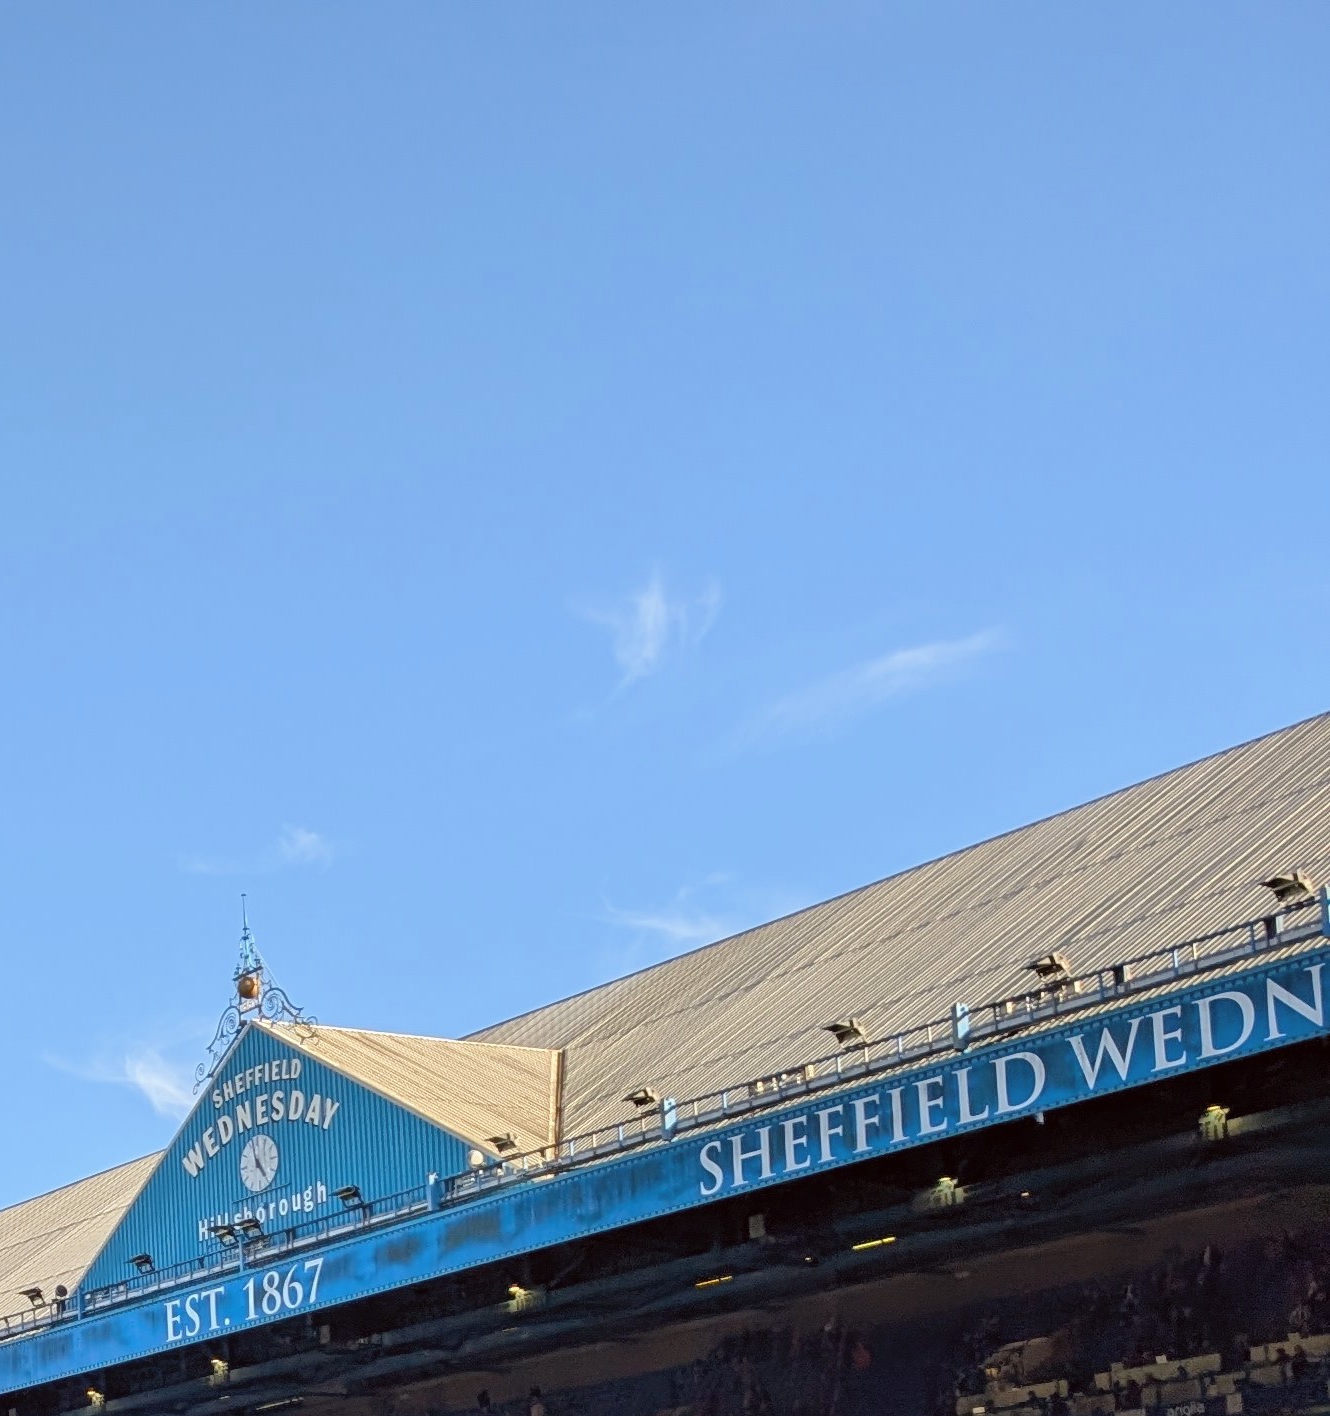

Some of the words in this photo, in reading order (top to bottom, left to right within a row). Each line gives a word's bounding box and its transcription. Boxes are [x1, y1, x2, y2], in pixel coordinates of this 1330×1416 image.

[212, 1058, 302, 1110] SHEFFIELD
[699, 1051, 1046, 1197] SHEFFIELD
[1067, 963, 1326, 1091] WEDN
[182, 1090, 340, 1179] WEDNESDAY
[165, 1286, 231, 1343] EST.
[243, 1257, 325, 1321] 1867
